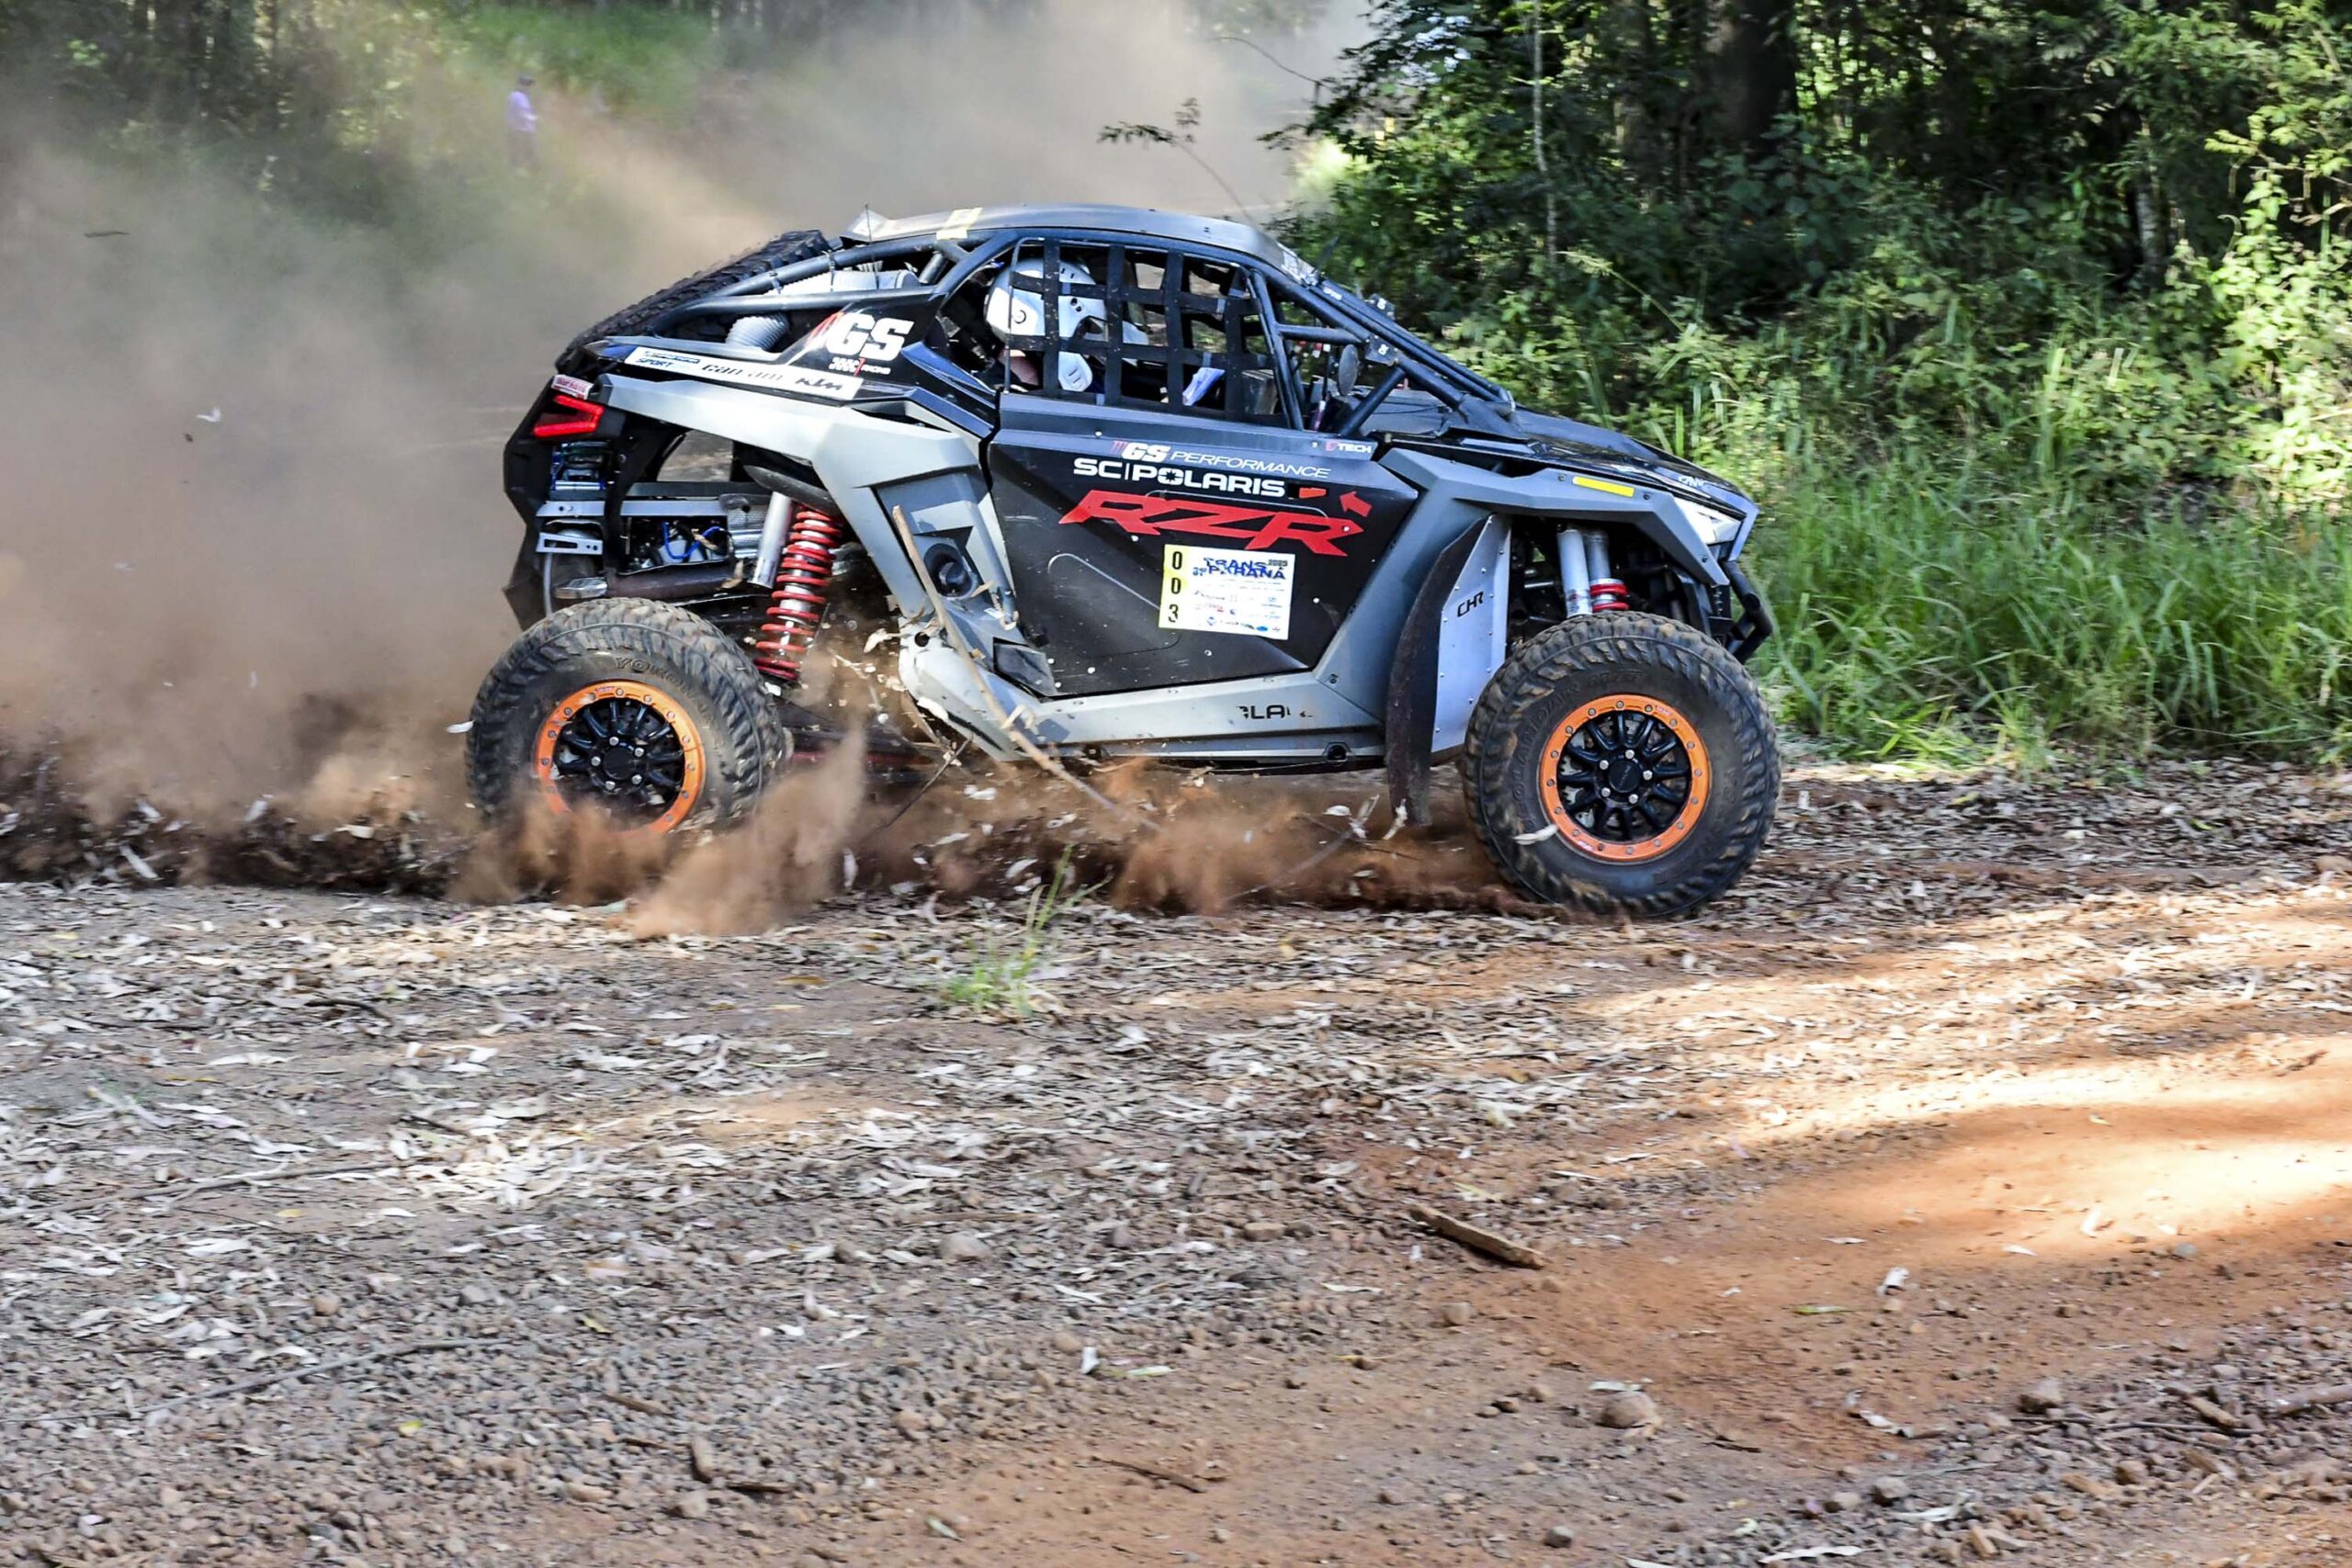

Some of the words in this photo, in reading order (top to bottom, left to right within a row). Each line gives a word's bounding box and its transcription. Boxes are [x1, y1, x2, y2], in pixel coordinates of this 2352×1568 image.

[825, 311, 915, 361] GS
[1120, 442, 1171, 463] GS
[1170, 451, 1332, 479] PERFORMANCE
[1132, 464, 1285, 498] POLARIS
[1058, 490, 1364, 557] RZR
[1204, 557, 1268, 570] TRANS
[1457, 591, 1484, 617] CHR
